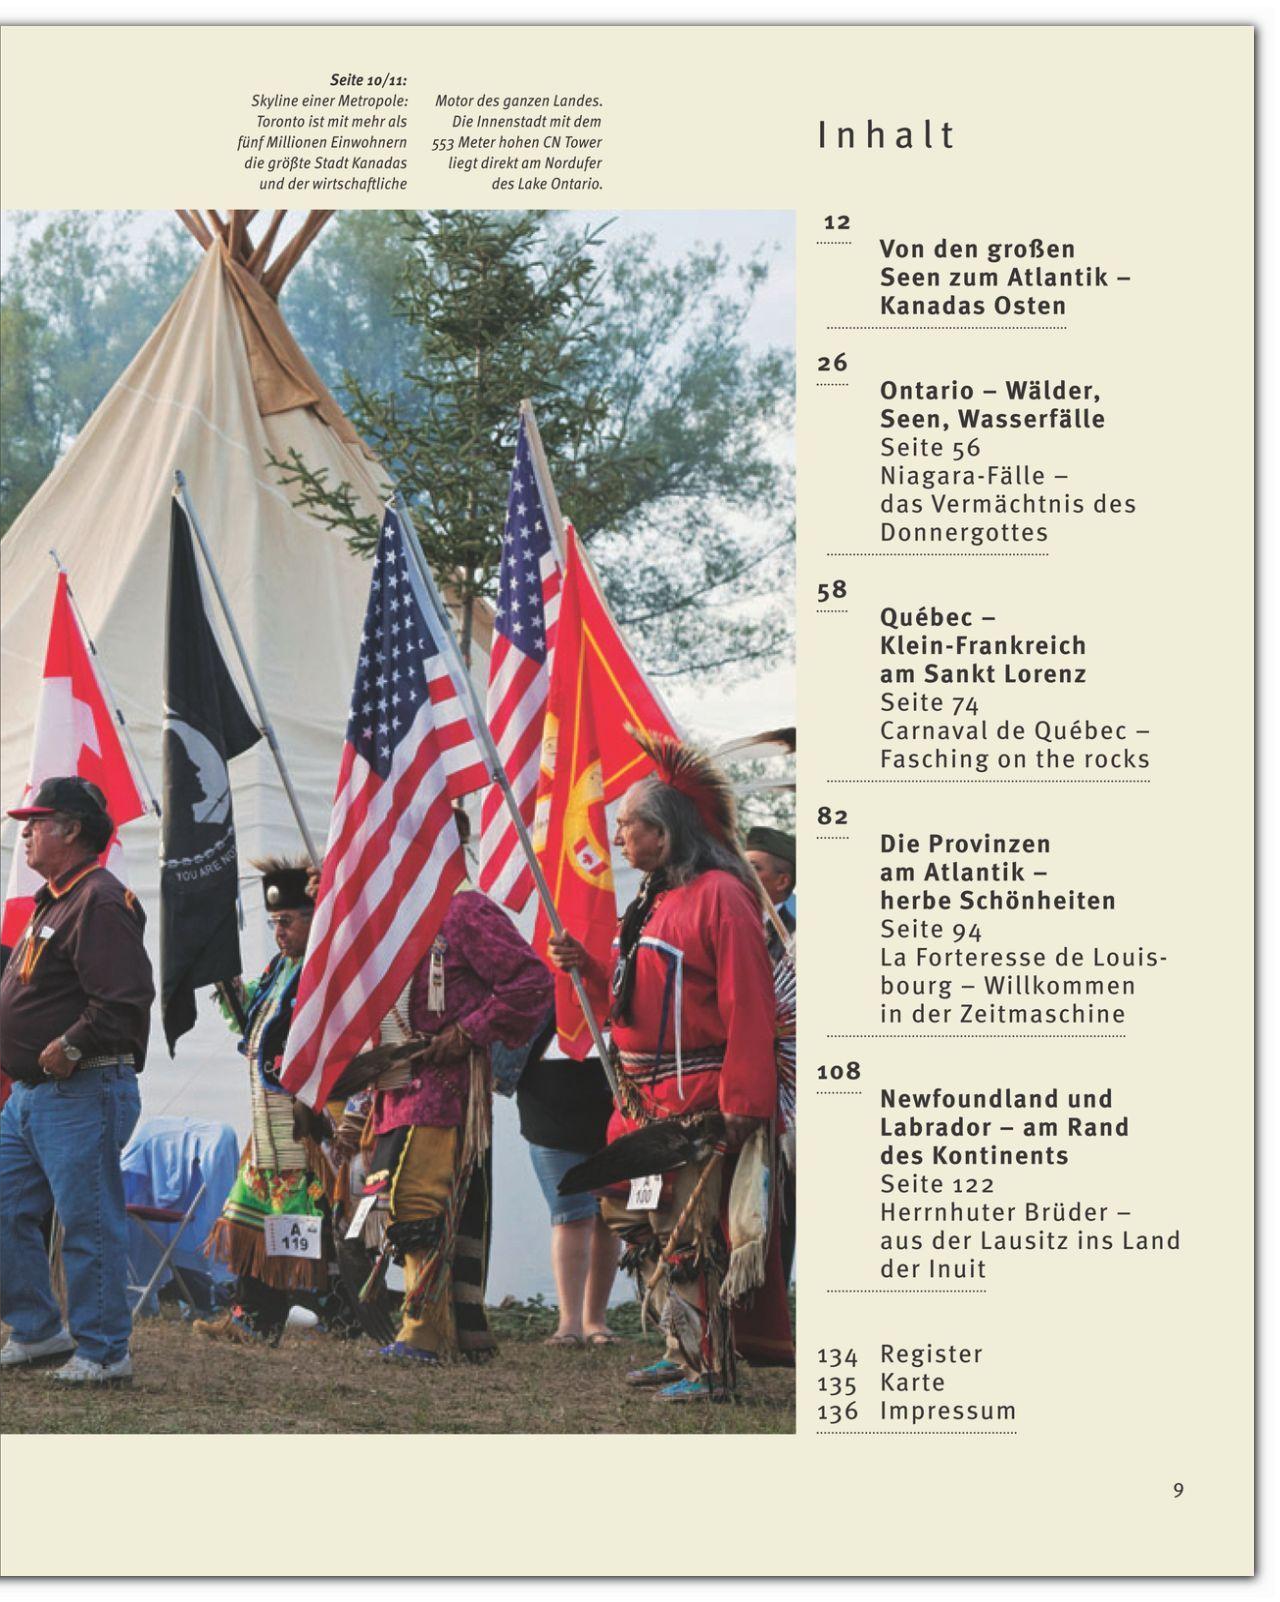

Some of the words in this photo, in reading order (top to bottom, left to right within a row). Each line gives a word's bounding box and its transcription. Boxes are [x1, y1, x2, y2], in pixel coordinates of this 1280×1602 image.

[329, 72, 364, 87] Seite
[366, 72, 408, 89] 10/11:
[250, 93, 299, 110] Skyline
[301, 93, 336, 108] einer
[337, 93, 409, 110] Metropole:
[435, 93, 475, 108] Motor
[476, 93, 500, 108] des
[502, 96, 550, 111] ganzen
[553, 93, 603, 108] Landes.
[819, 118, 954, 149] Inhalt
[244, 155, 265, 170] die
[267, 155, 312, 173] größte
[313, 155, 350, 170] Stadt
[351, 155, 408, 170] Kanadas
[448, 155, 479, 173] liegt
[480, 155, 519, 170] direkt
[521, 159, 542, 170] am
[544, 155, 603, 172] Nordufer
[491, 176, 515, 191] des
[517, 176, 548, 191] Lake
[550, 176, 603, 191] Ontario.
[824, 214, 851, 230] 12
[878, 238, 924, 259] Von
[933, 237, 978, 259] den
[987, 238, 1075, 264] großen
[880, 266, 940, 287] Seen
[948, 271, 998, 287] zum
[1006, 266, 1109, 288] Atlantik
[880, 294, 986, 316] Kanadas
[993, 295, 1066, 316] Osten
[817, 351, 848, 373] 26
[880, 379, 974, 401] Ontario
[1004, 379, 1100, 404] Wälder,
[880, 408, 950, 432] Seen,
[957, 407, 1105, 429] Wasserfälle
[880, 436, 944, 457] Seite
[952, 437, 981, 462] 56
[881, 464, 1045, 490] Niagara-Fälle
[880, 492, 923, 514] das
[930, 492, 1085, 514] Vermächtnis
[1093, 492, 1137, 514] des
[881, 522, 1048, 547] Donnergottes
[817, 579, 848, 603] 58
[880, 605, 973, 630] Québec
[880, 634, 1086, 656] Klein-Frankreich
[880, 691, 944, 712] Seite
[952, 696, 979, 717] 74
[880, 719, 988, 741] Carnaval
[996, 719, 1025, 741] de
[1034, 719, 1127, 743] Québec
[881, 747, 990, 773] Fasching
[997, 753, 1026, 769] on
[1035, 747, 1075, 769] the
[1084, 747, 1150, 769] rocks
[817, 805, 848, 826] 82
[880, 832, 920, 854] Die
[929, 832, 1050, 854] Provinzen
[175, 870, 198, 882] YOU
[199, 860, 222, 877] ARE
[880, 866, 915, 882] am
[923, 861, 1025, 883] Atlantik
[880, 889, 952, 911] herbe
[959, 889, 1115, 911] Schönheiten
[881, 947, 906, 967] La
[916, 947, 1046, 967] Forteresse
[1055, 946, 1084, 967] de
[1093, 946, 1167, 968] Louis-
[880, 974, 953, 1000] bourg
[983, 974, 1135, 996] Willkommen
[816, 1060, 861, 1081] 108
[880, 1087, 1058, 1109] Newfoundland
[1068, 1087, 1113, 1109] und
[880, 1115, 992, 1138] Labrador
[1022, 1121, 1058, 1137] am
[1068, 1115, 1129, 1137] Rand
[880, 1144, 924, 1166] des
[932, 1144, 1069, 1166] Kontinents
[880, 1172, 944, 1194] Seite
[952, 1178, 994, 1194] 122
[881, 1201, 1016, 1222] Herrnhuter
[1025, 1201, 1108, 1222] Brüder
[290, 1222, 302, 1236] A
[880, 1234, 923, 1251] aus
[931, 1229, 972, 1251] der
[981, 1229, 1068, 1251] Lausitz
[1077, 1229, 1114, 1251] ins
[1123, 1229, 1180, 1251] Land
[281, 1236, 309, 1251] 119
[880, 1257, 921, 1279] der
[929, 1258, 986, 1279] Inuit
[817, 1347, 859, 1368] 134
[881, 1343, 983, 1368] Register
[817, 1376, 857, 1397] 135
[881, 1372, 945, 1392] Karte
[817, 1400, 859, 1425] 136
[881, 1400, 1016, 1425] Impressum
[1173, 1482, 1185, 1499] 9
